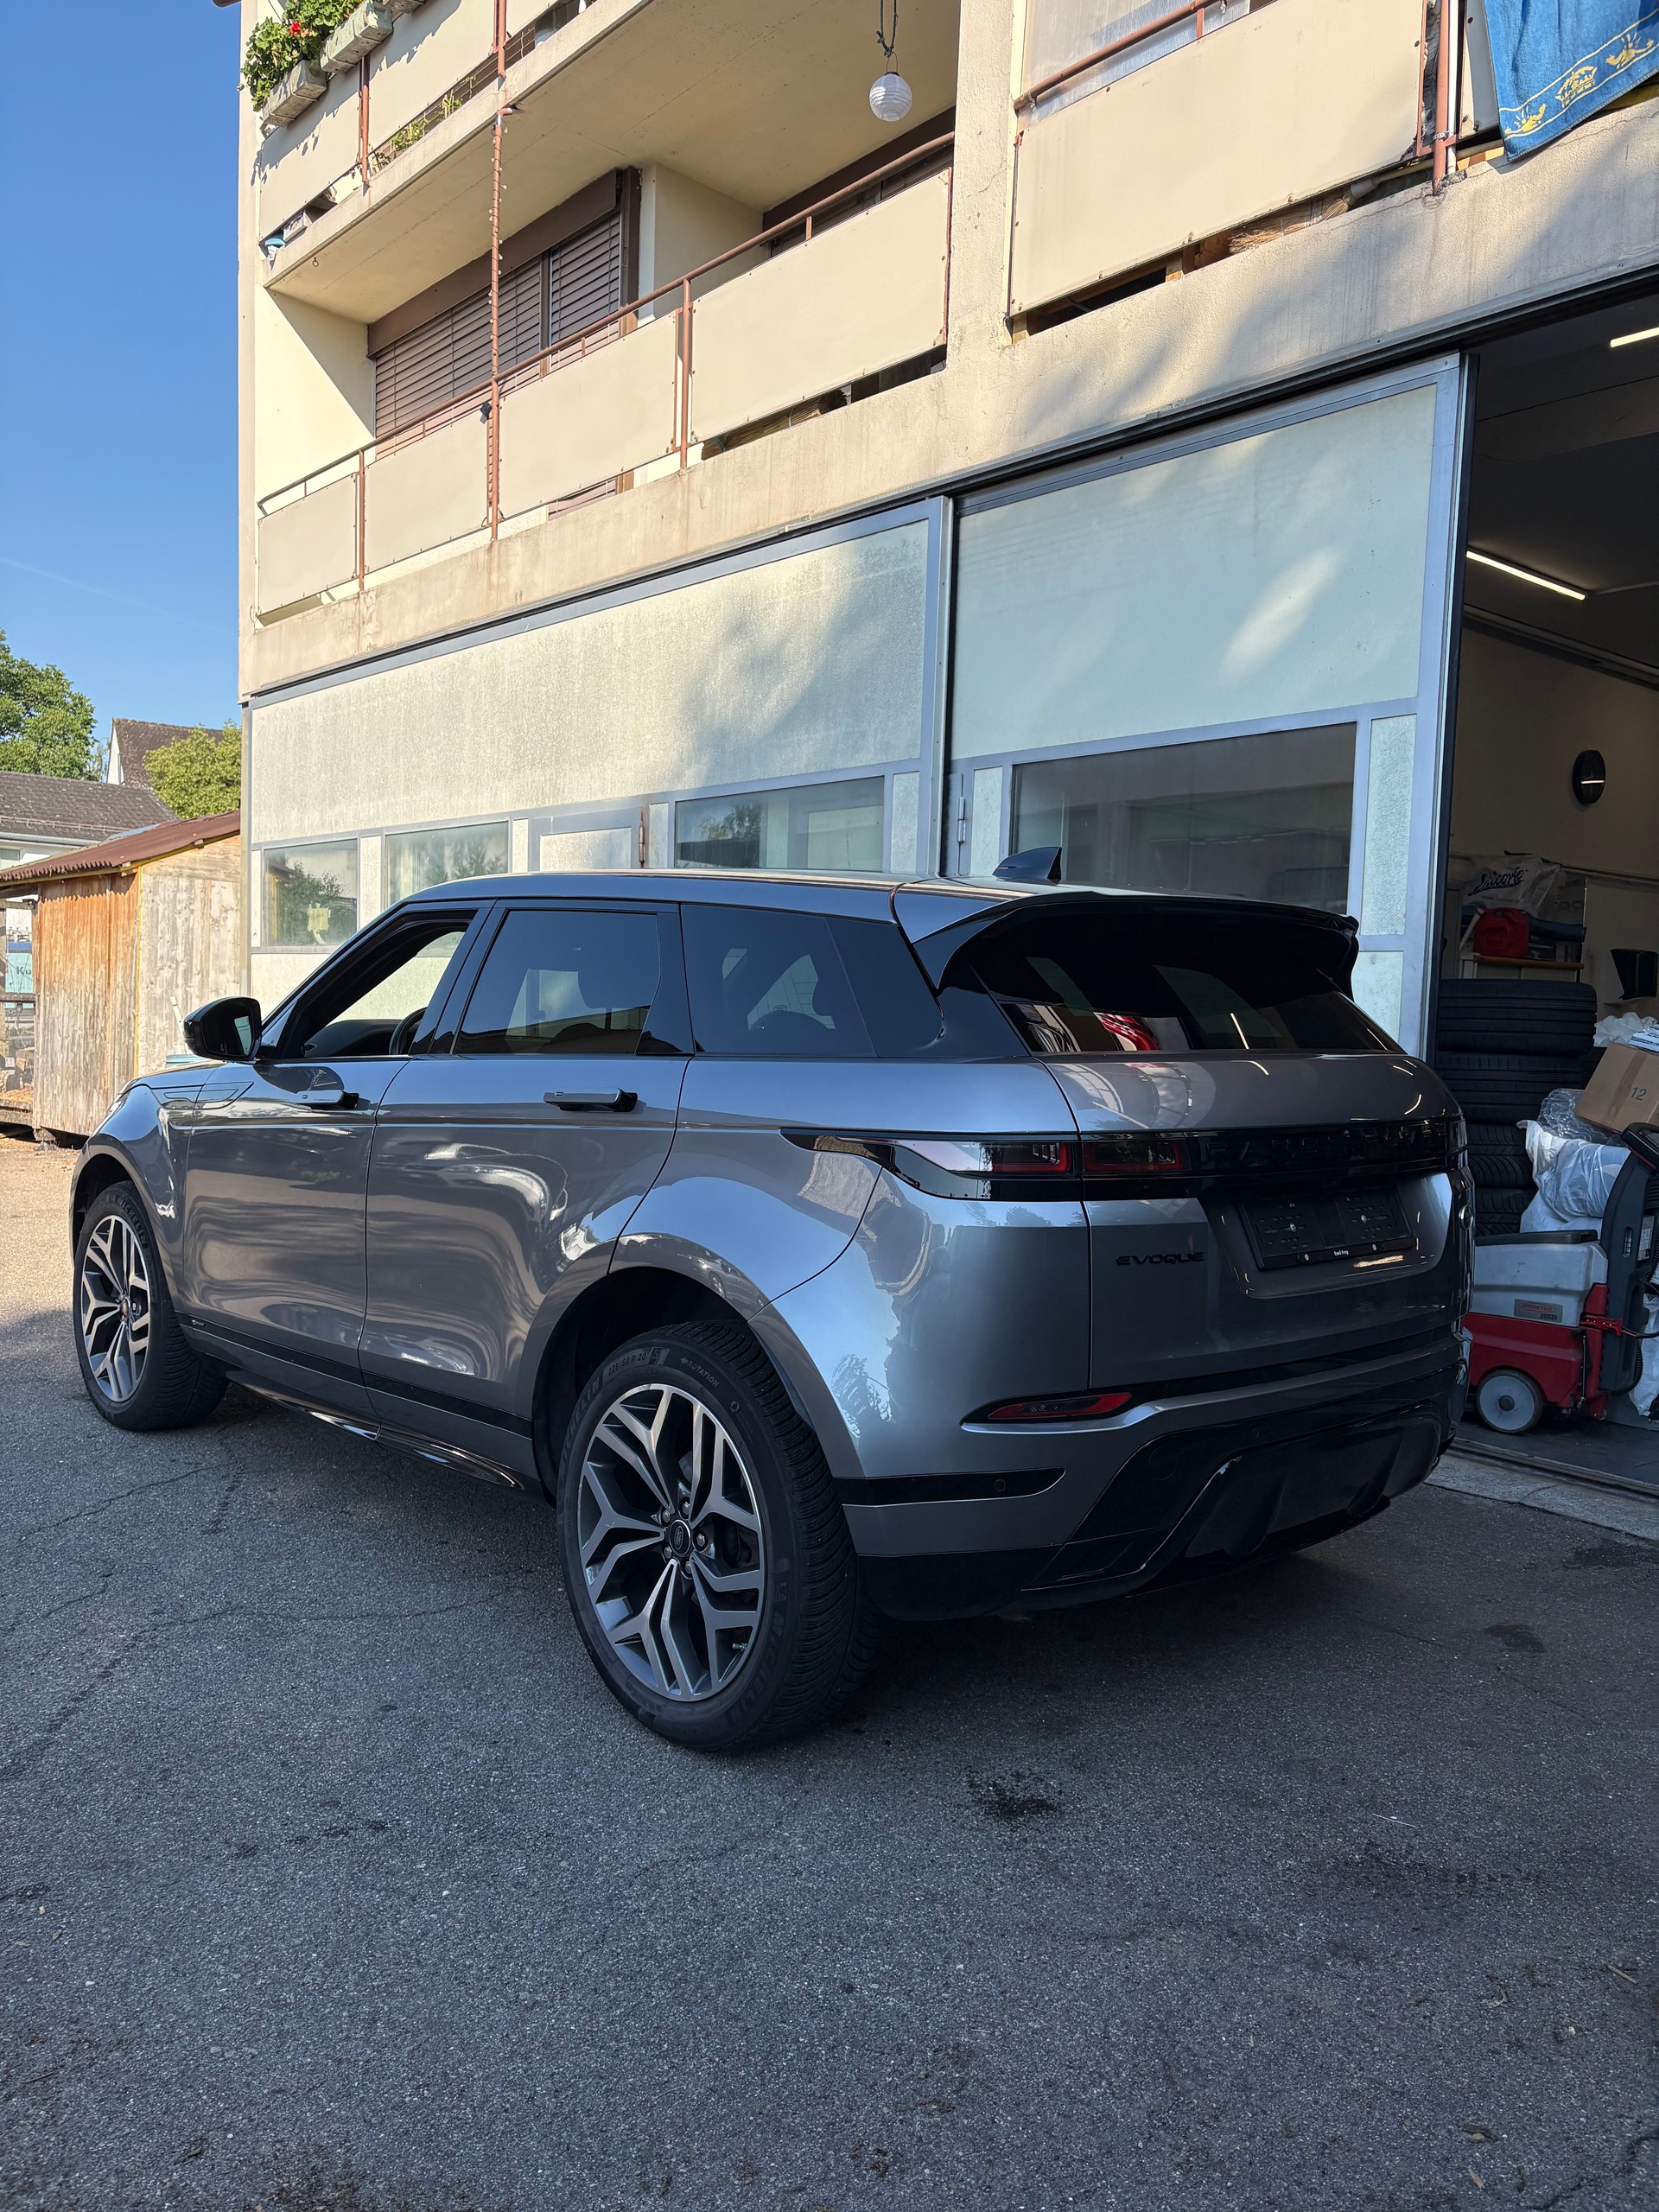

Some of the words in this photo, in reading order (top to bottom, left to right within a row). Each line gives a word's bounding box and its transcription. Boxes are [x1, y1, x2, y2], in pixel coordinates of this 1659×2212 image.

[1631, 1087, 1647, 1101] 12
[116, 1197, 148, 1244] MICHELIN
[1116, 1251, 1205, 1265] EVOQUE
[607, 1357, 630, 1376] 235/50
[638, 1352, 647, 1362] 20
[685, 1361, 720, 1388] ROTATION
[560, 1376, 601, 1482] MICHELIN
